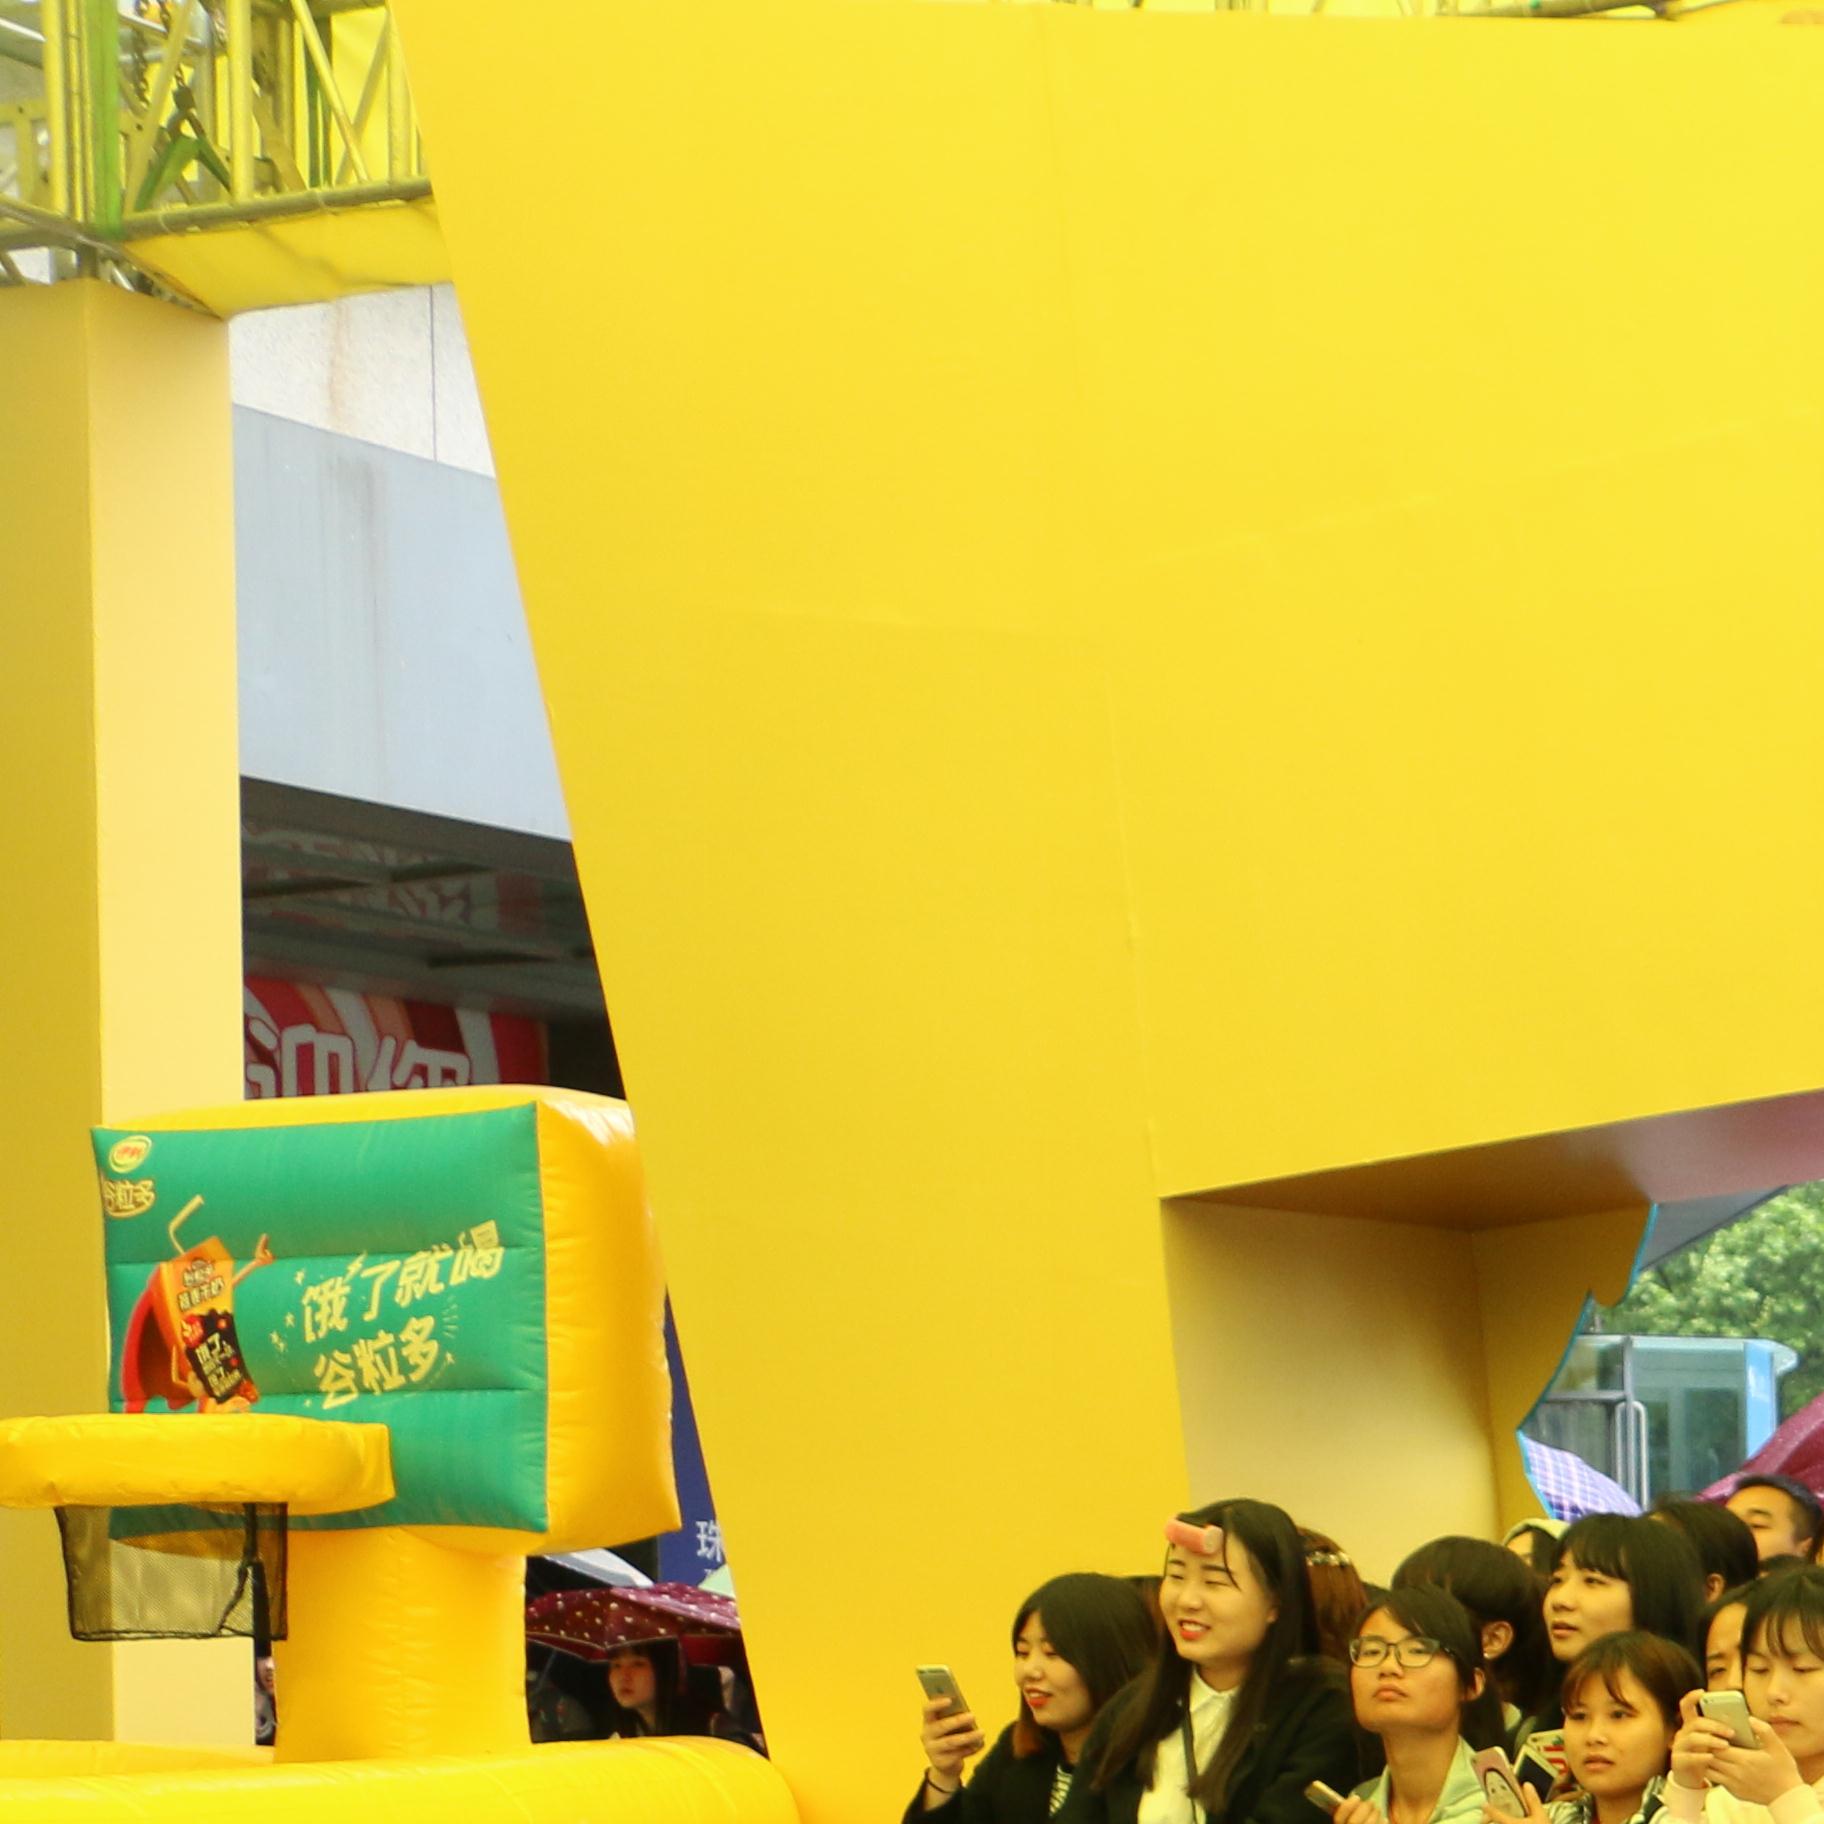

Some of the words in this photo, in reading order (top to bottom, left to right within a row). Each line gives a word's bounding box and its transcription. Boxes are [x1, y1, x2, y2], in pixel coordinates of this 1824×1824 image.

[302, 1219, 504, 1343] 饿了就喝
[314, 1315, 439, 1410] 谷粒多
